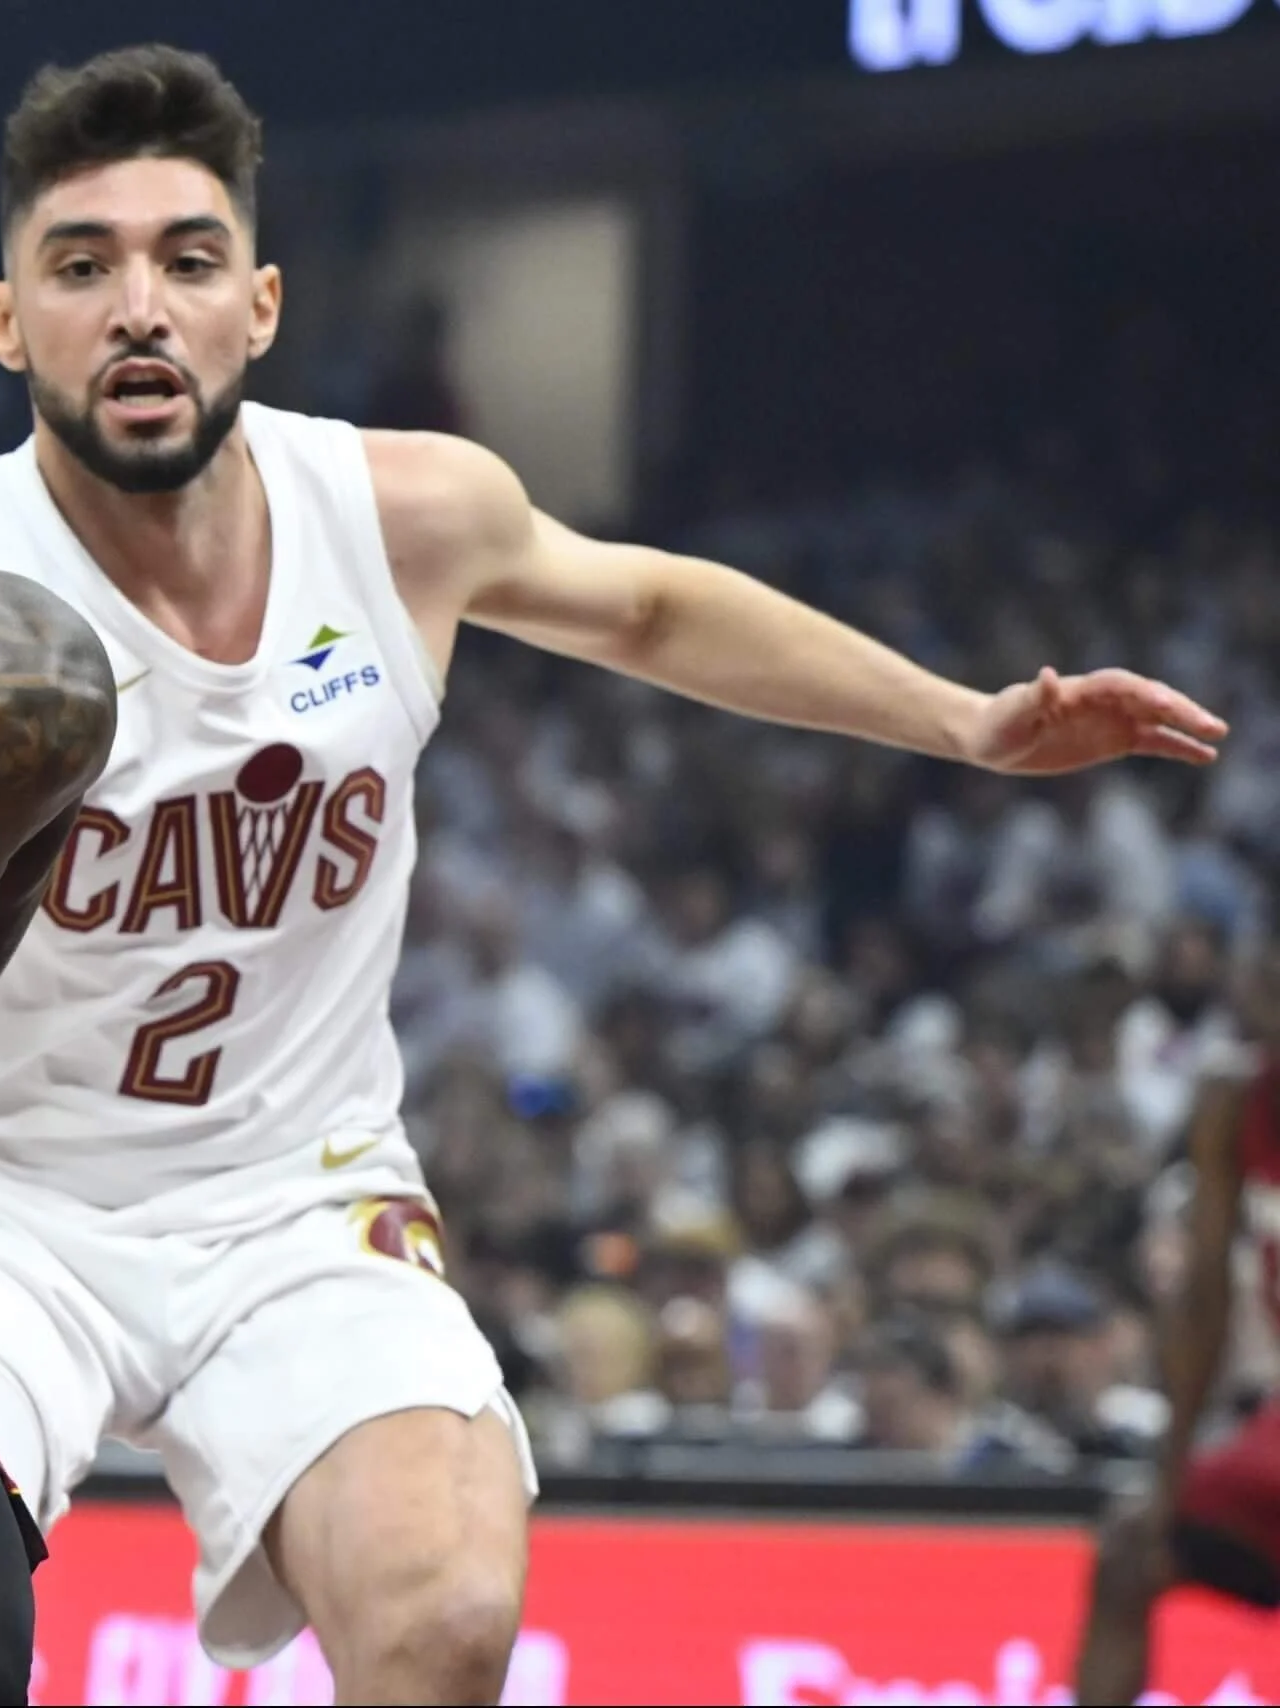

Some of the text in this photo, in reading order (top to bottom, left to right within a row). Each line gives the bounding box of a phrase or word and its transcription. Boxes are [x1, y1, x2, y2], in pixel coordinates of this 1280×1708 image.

[290, 664, 381, 714] CLIFFS
[42, 766, 387, 934] CAVS
[118, 959, 241, 1107] 2
